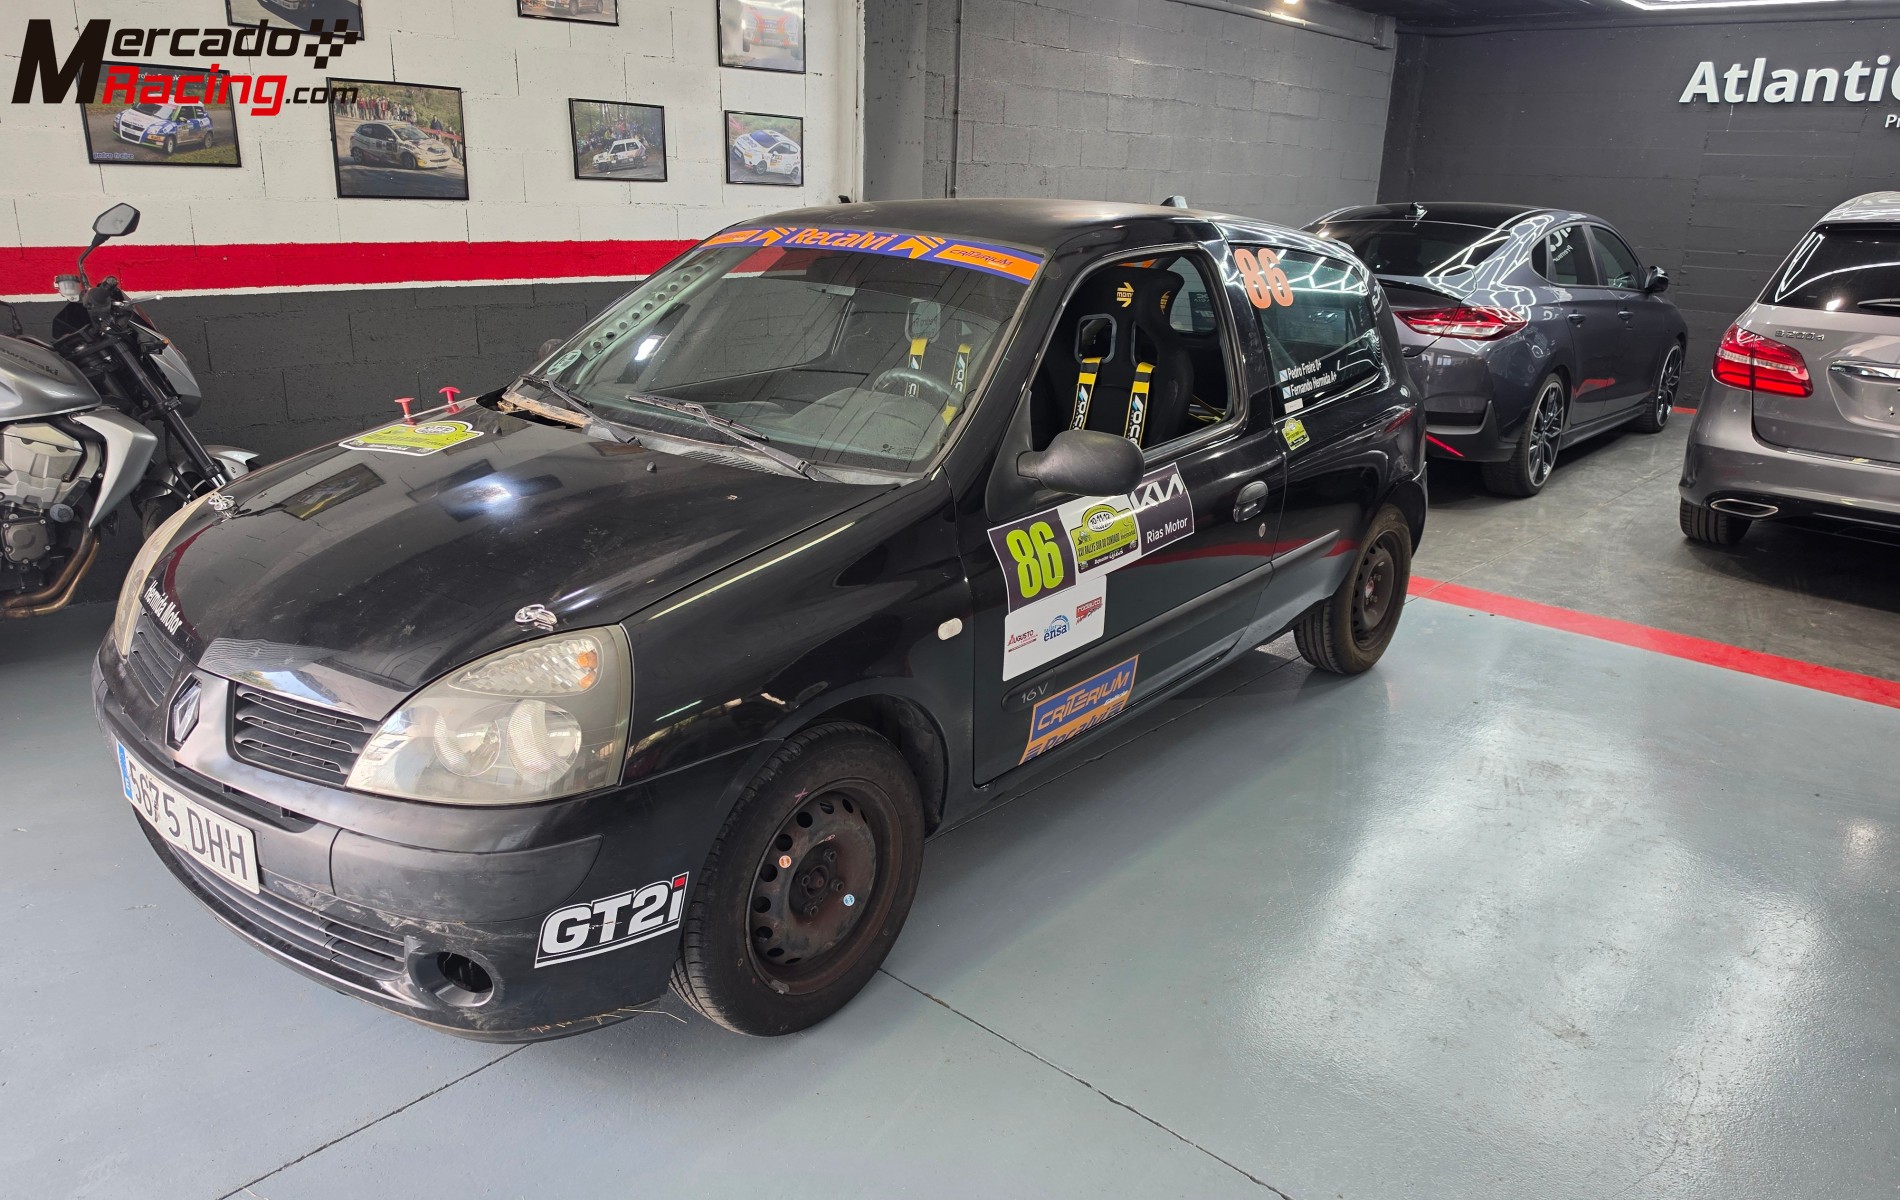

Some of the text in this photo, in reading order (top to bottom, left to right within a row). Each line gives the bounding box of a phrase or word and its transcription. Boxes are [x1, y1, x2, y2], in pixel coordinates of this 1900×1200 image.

[1678, 54, 1900, 103] Atlanti
[785, 228, 898, 250] Recalvi
[1234, 247, 1294, 309] 86
[1146, 528, 1164, 543] Rias
[1164, 517, 1188, 536] Motor
[1006, 521, 1065, 599] 86
[144, 580, 183, 635] Hermida Motor
[1043, 624, 1068, 642] ensa
[1037, 671, 1130, 731] CRITERIUM
[128, 760, 248, 881] 5675 DHH
[541, 876, 686, 954] GT2i
